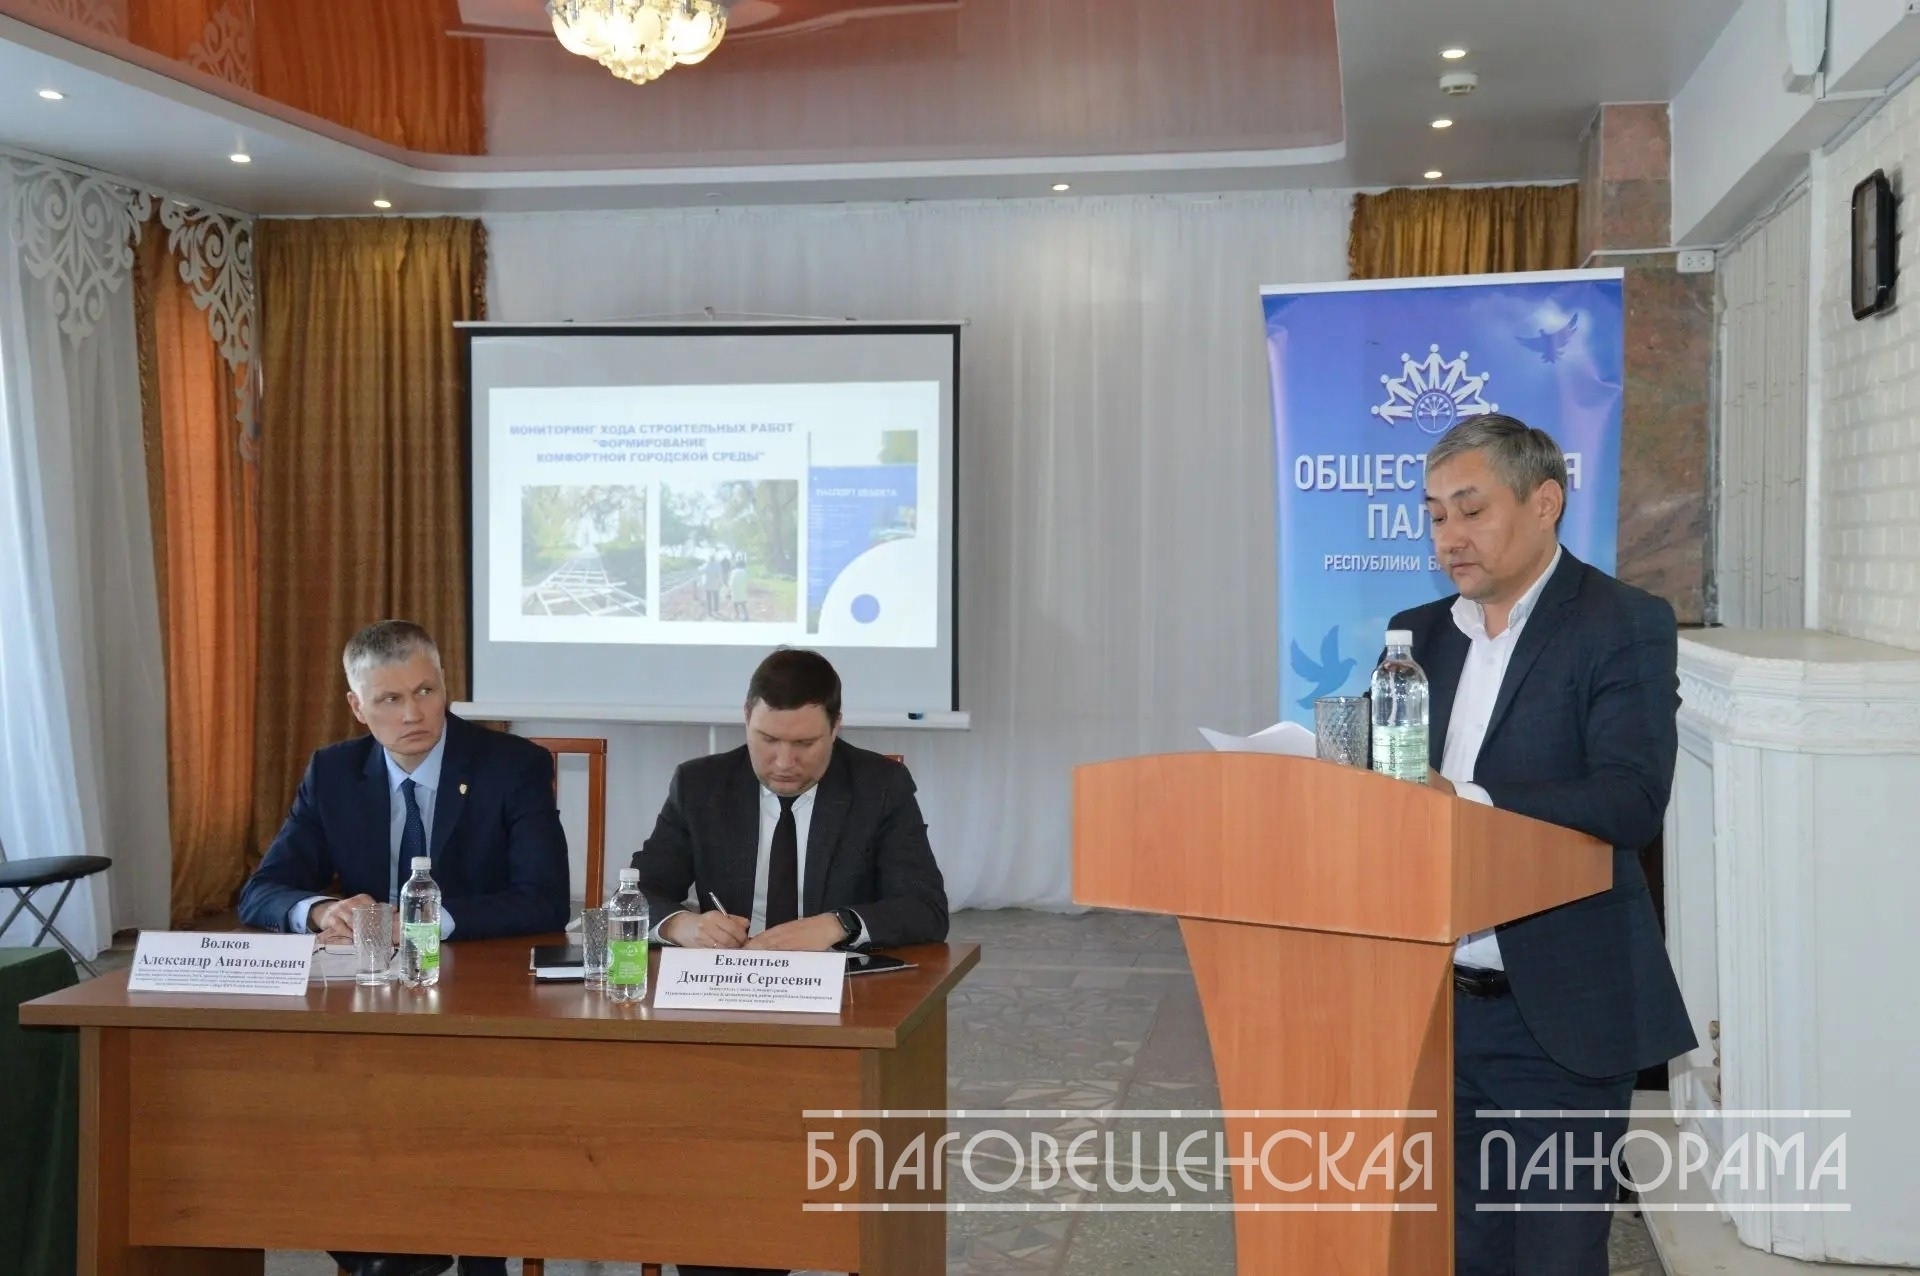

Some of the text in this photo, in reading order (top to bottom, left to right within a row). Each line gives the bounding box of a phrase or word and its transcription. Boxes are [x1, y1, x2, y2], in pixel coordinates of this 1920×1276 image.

[509, 422, 794, 435] МОНИТОРИНГ ХОДА СТРОИТЕЛЬНЫХ РАБОТ
[1324, 554, 1421, 571] РЕСПУБЛИКИ
[200, 937, 251, 951] Волков
[138, 954, 306, 970] Александр Анатольевич
[715, 954, 790, 968] Евлентьев
[676, 970, 822, 988] Дмитрий Сергеевич
